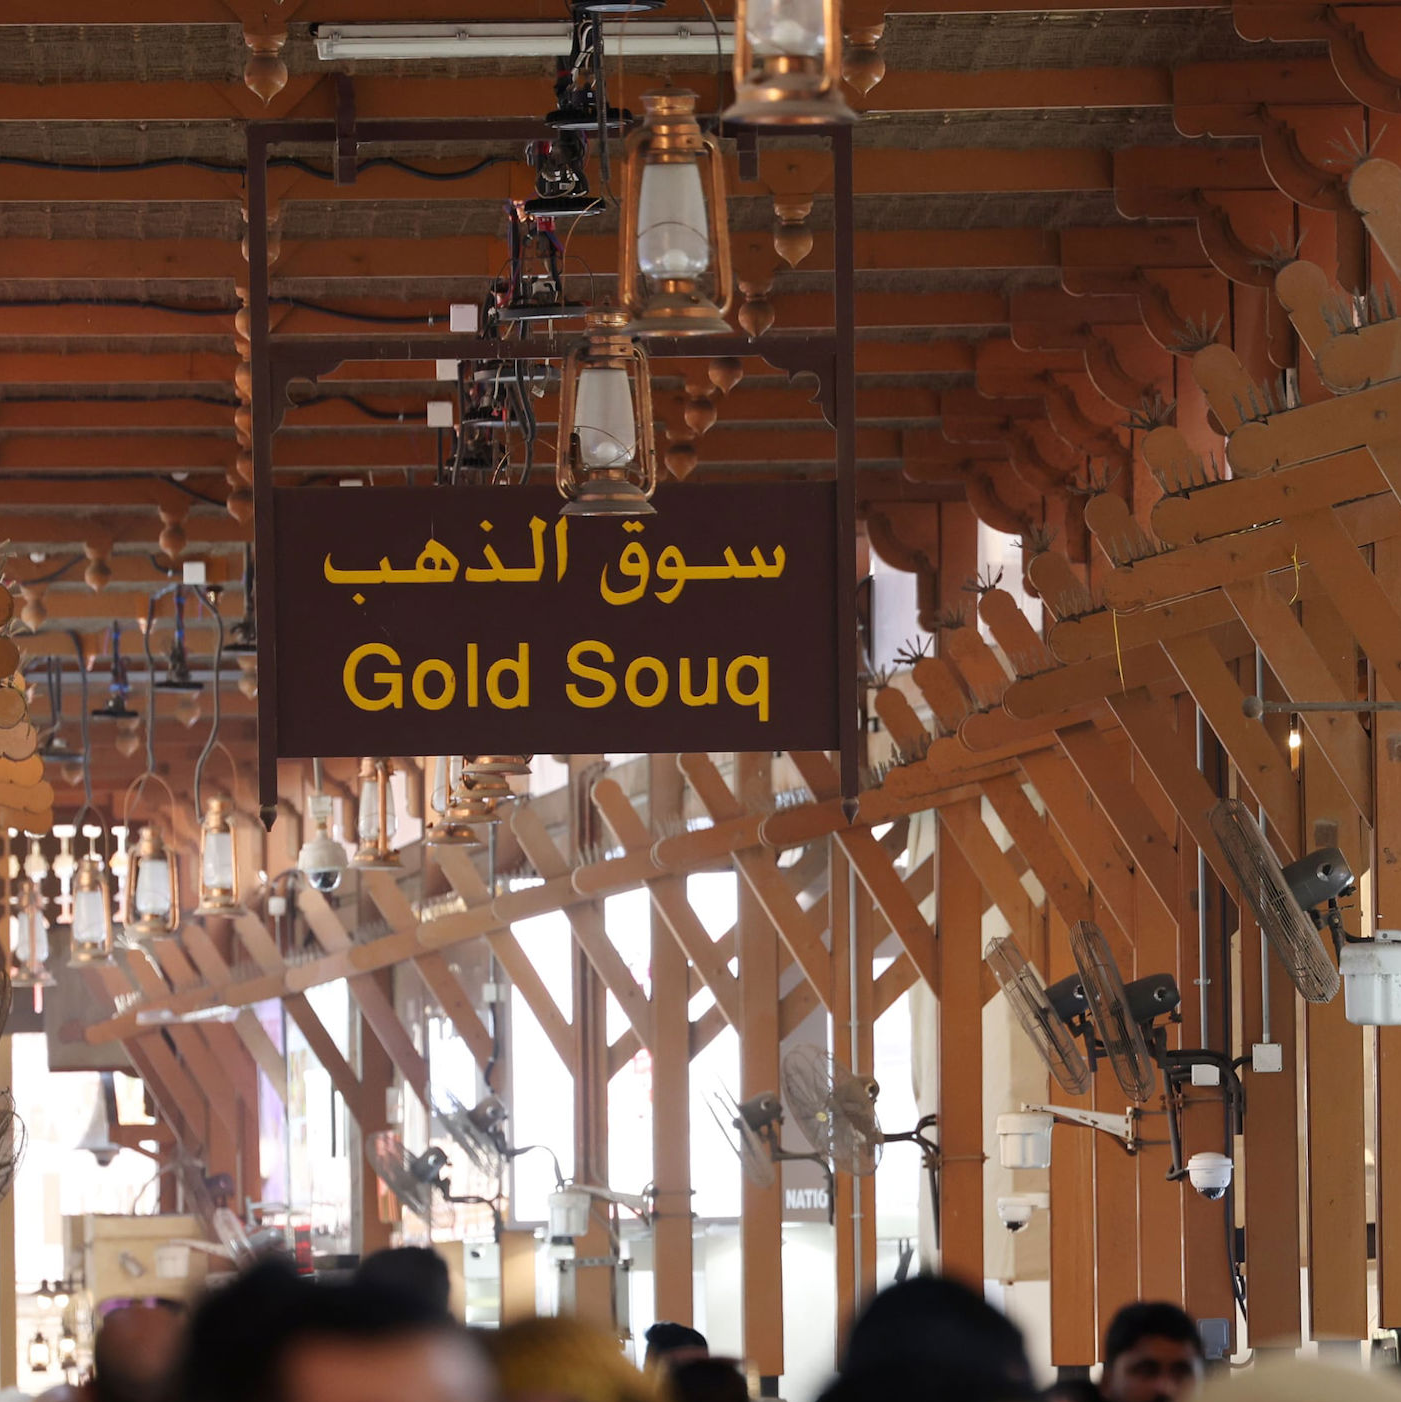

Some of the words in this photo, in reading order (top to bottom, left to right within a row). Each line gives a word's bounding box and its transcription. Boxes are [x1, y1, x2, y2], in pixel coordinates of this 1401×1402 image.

[323, 515, 569, 606] الذهب
[600, 520, 787, 606] سوق
[342, 642, 530, 712] Gold
[565, 640, 770, 722] Souq
